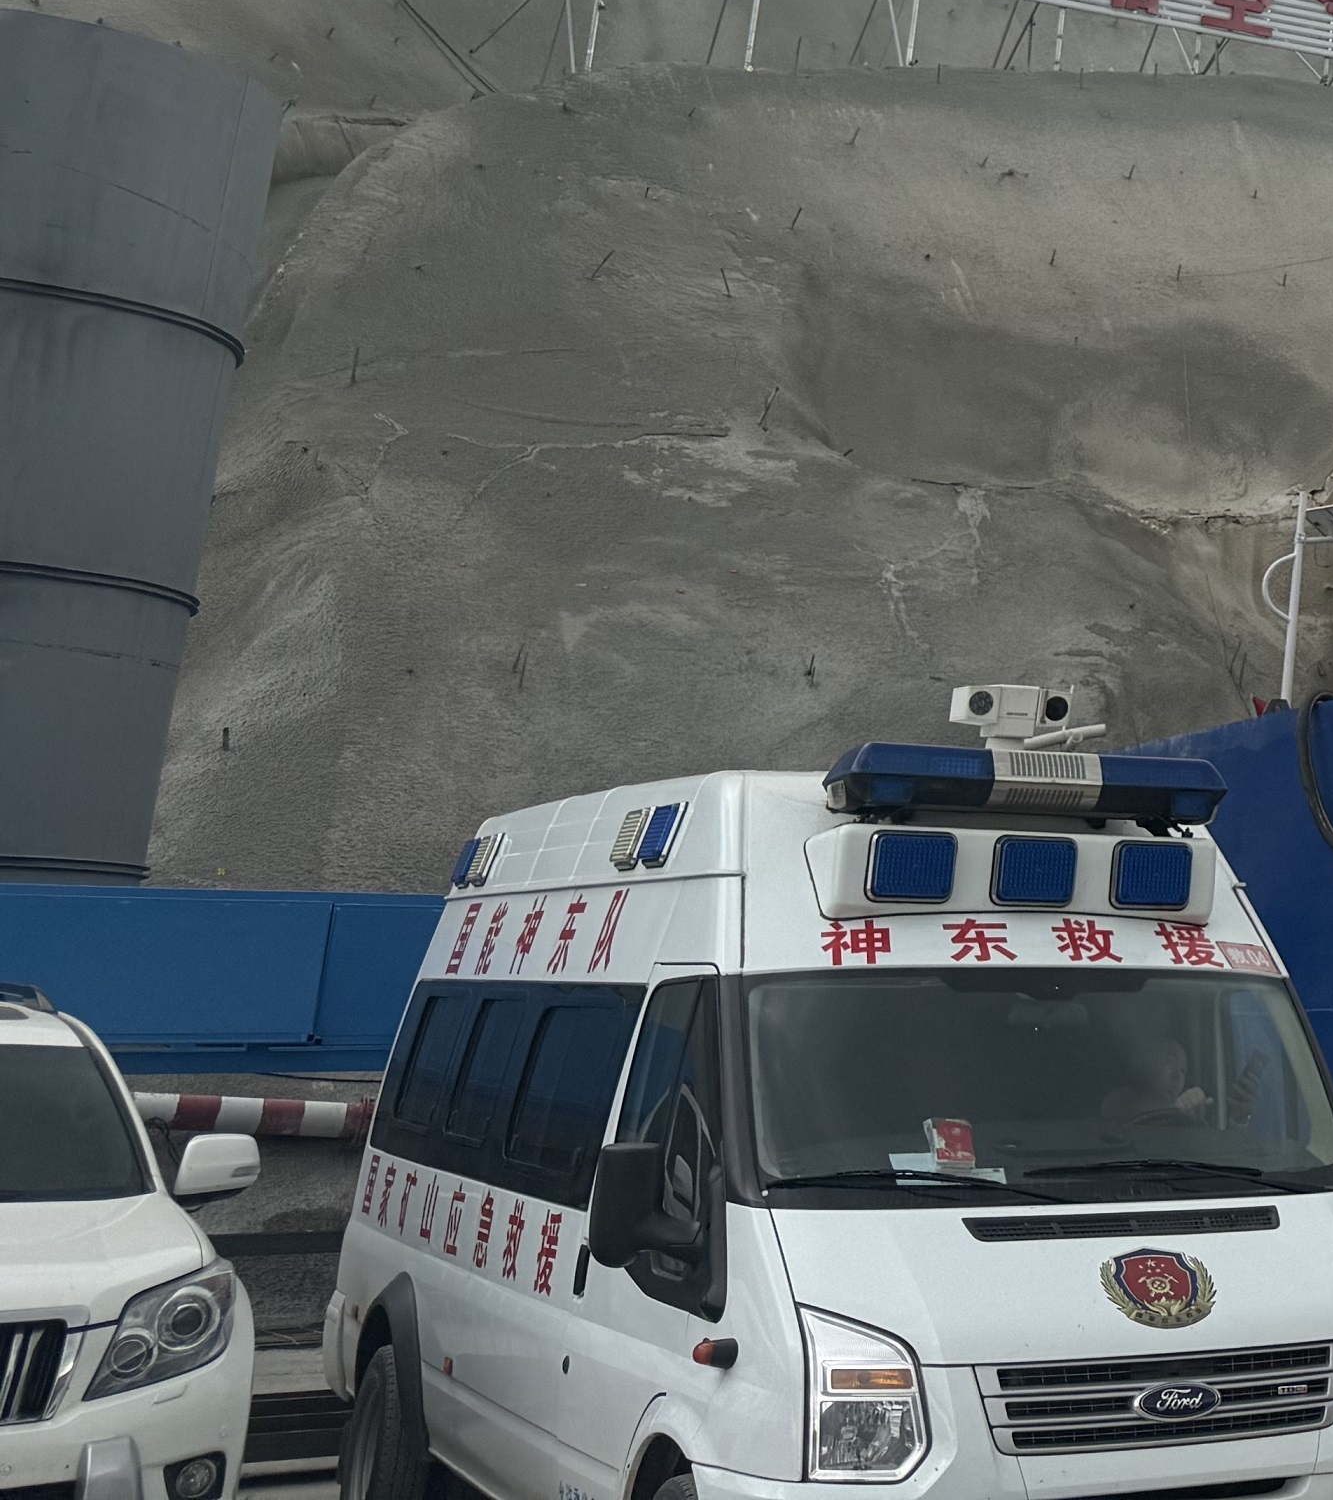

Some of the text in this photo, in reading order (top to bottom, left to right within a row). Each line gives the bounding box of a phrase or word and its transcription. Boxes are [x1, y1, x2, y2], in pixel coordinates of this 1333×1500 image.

[445, 888, 630, 975] 国能神东队
[820, 918, 1225, 967] 神东救援
[362, 1154, 563, 1297] 国家矿山应急救援
[1156, 1388, 1204, 1411] Ford
